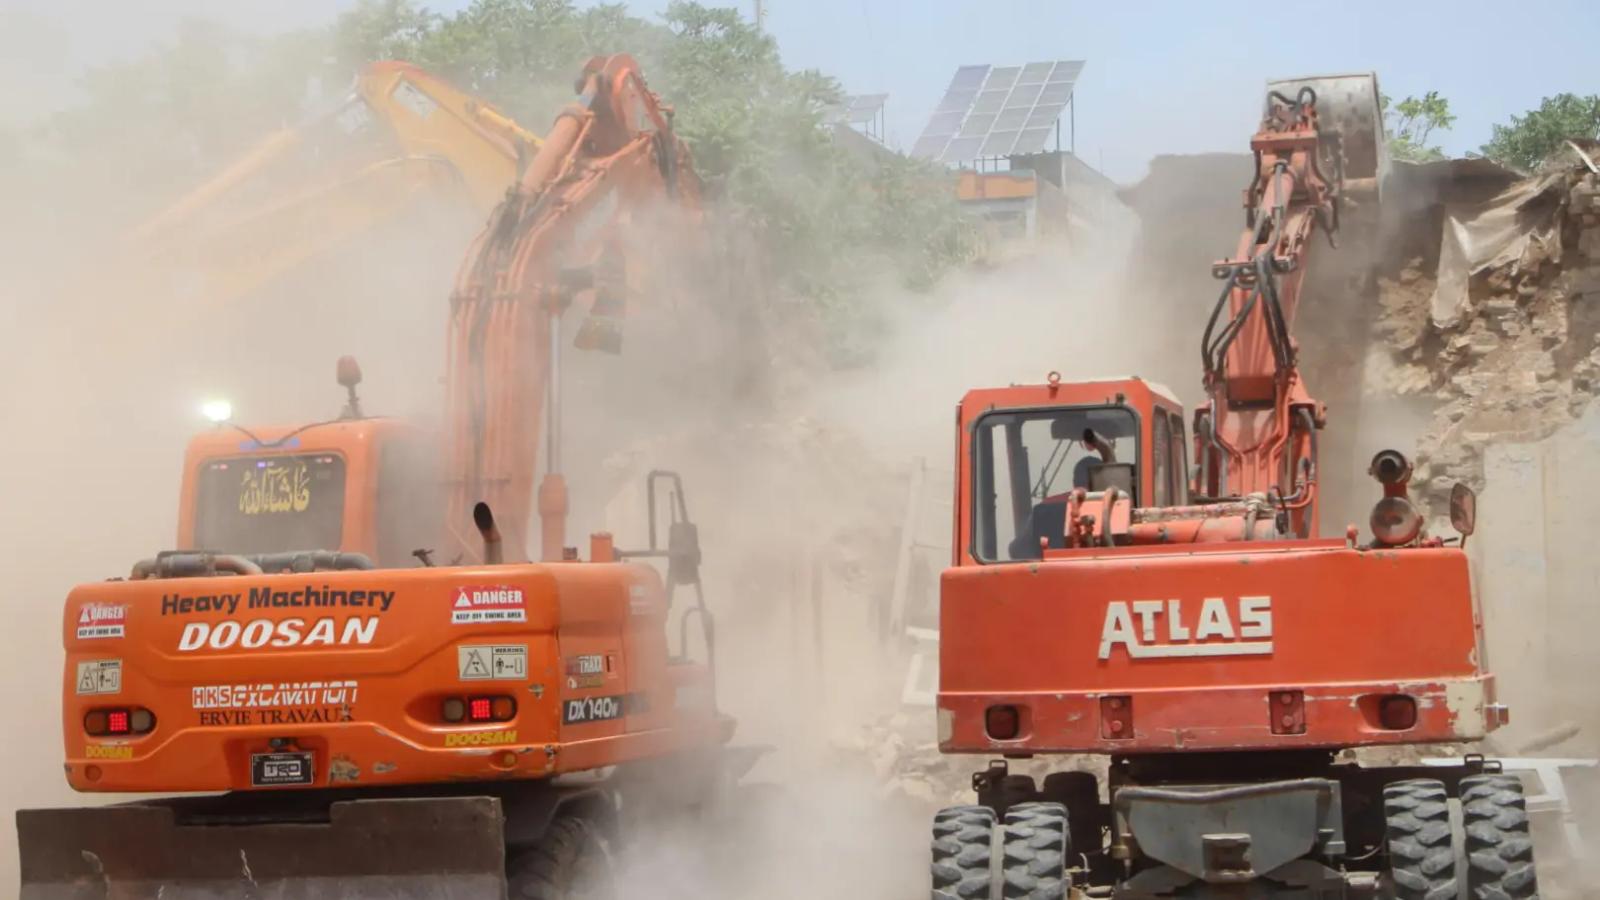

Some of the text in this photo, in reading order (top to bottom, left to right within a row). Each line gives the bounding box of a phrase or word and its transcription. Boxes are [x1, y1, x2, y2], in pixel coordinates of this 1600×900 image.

[161, 585, 396, 615] Heavy Machinery
[473, 590, 523, 604] DANGER
[92, 606, 124, 620] DANGER
[178, 616, 380, 651] DOOSAN
[1098, 595, 1273, 659] ATLAS
[444, 729, 518, 747] DOOSAN
[86, 744, 133, 759] DOOSAN
